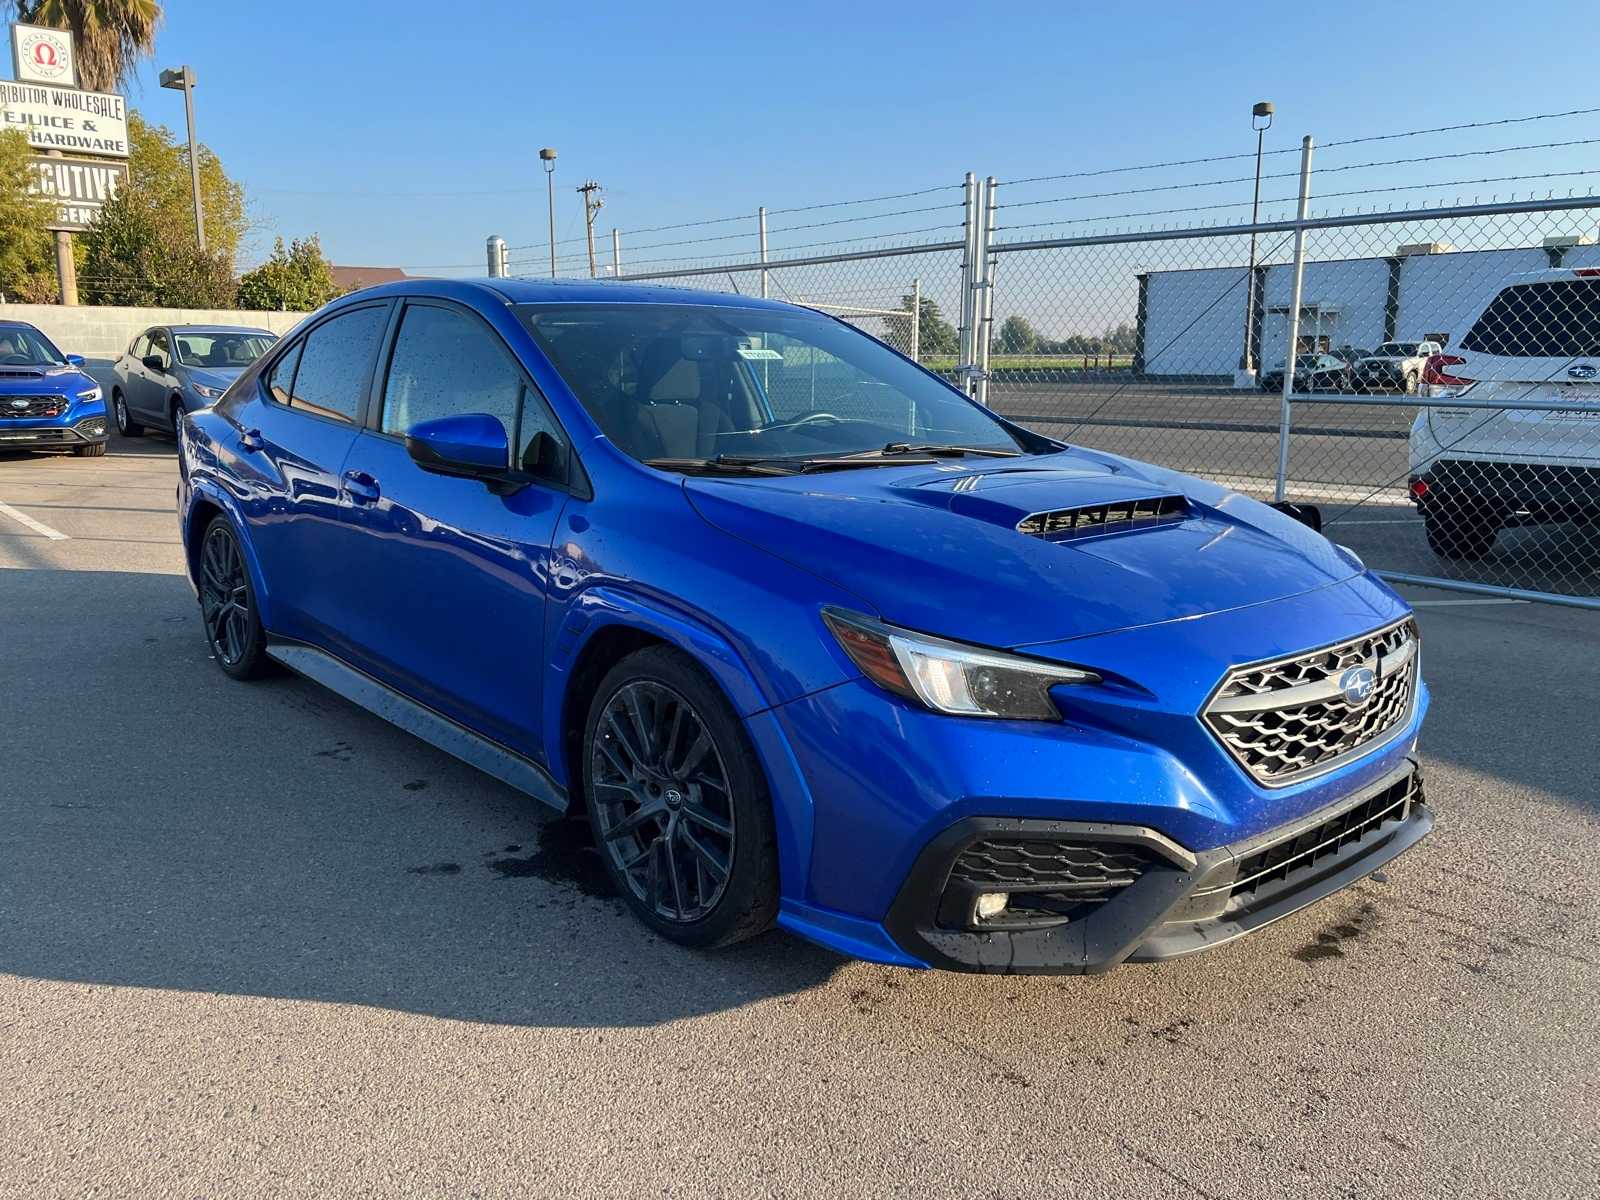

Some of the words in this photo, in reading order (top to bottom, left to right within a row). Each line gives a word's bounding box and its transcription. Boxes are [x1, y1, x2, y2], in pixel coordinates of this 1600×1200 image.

[51, 90, 123, 121] WHOLESALE
[82, 119, 98, 132] &
[31, 131, 125, 153] HARDWARE
